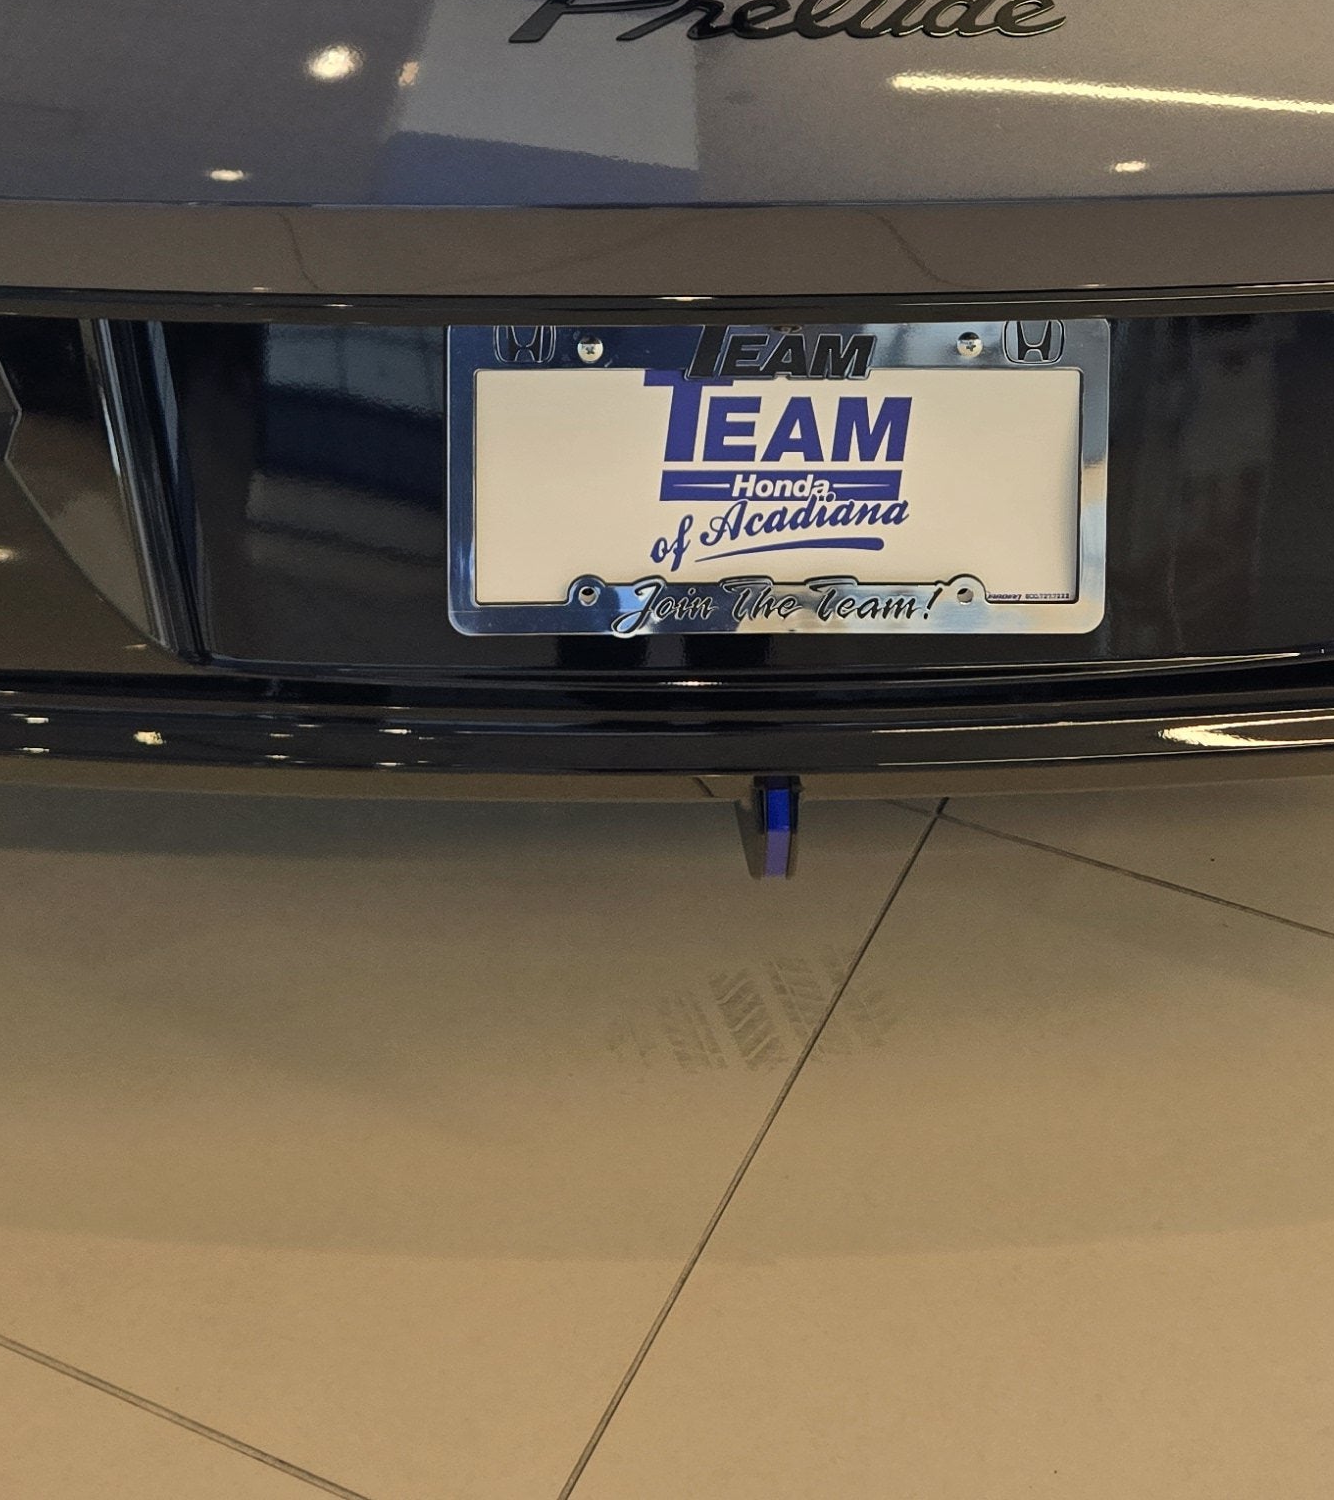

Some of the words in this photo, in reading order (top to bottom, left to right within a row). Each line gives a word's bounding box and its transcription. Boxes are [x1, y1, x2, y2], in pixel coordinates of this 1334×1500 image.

[643, 368, 913, 462] TEAM
[731, 474, 831, 498] Honda
[650, 514, 694, 572] of
[699, 492, 910, 547] Acadiana
[611, 576, 714, 634] Join
[719, 575, 802, 623] The
[806, 575, 944, 623] Team!
